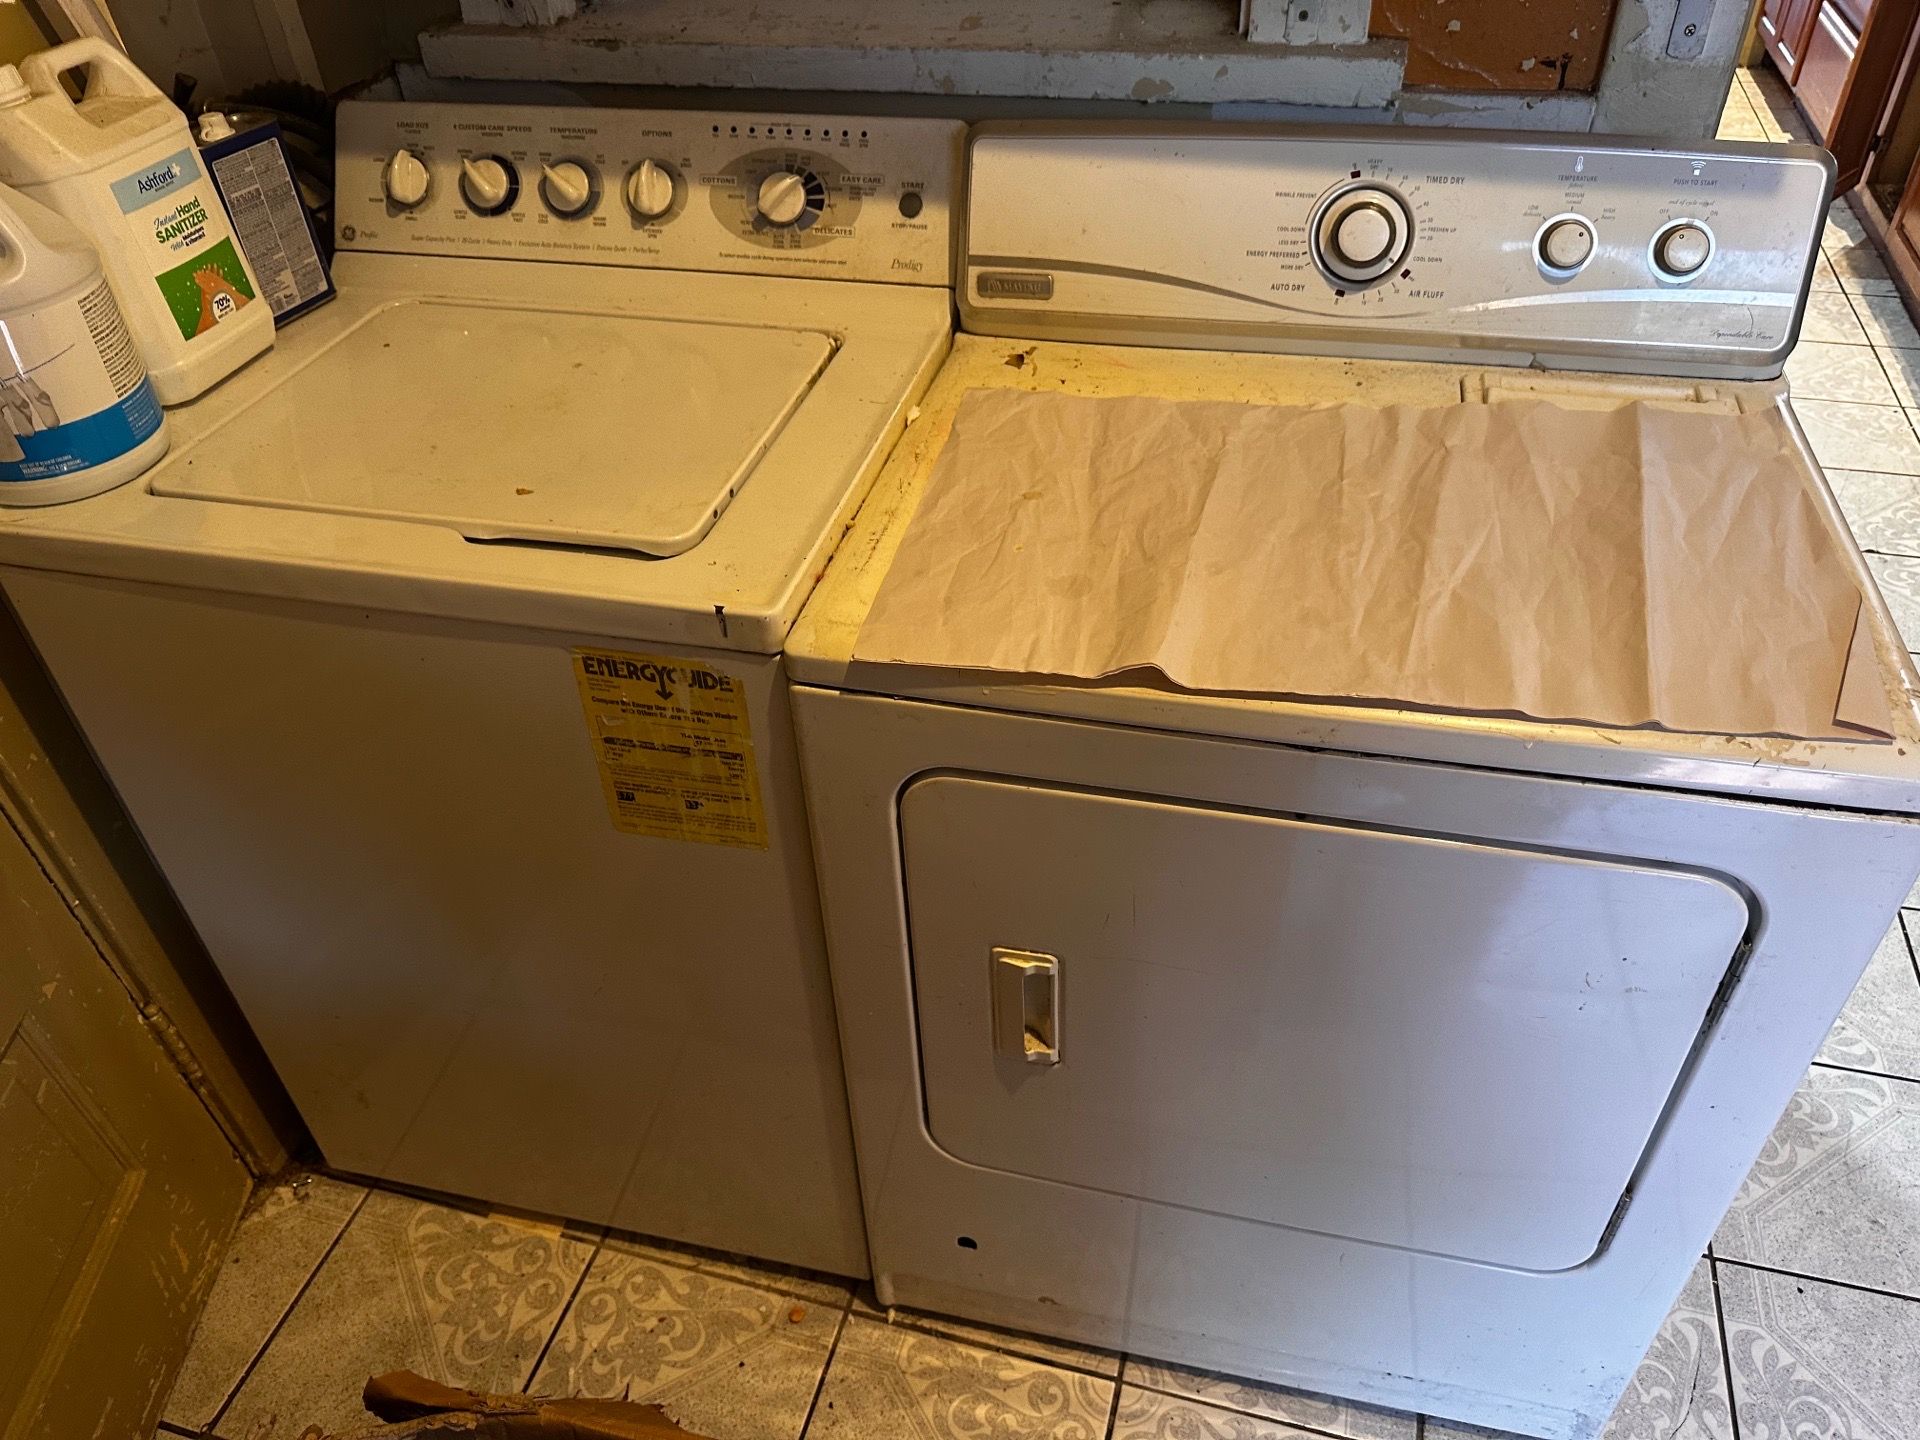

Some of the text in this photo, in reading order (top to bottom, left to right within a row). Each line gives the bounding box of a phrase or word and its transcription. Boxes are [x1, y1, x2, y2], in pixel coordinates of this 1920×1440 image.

[550, 127, 598, 135] TEMPERATURE
[642, 130, 672, 138] OPTIONS
[138, 166, 174, 194] Ashford
[702, 176, 736, 184] COTTONS
[863, 176, 881, 184] CARE
[1426, 176, 1465, 184] TIMED DRY
[176, 196, 200, 217] Hand
[156, 208, 208, 243] SANITIZER
[892, 222, 927, 230] STOP/PAUSE
[814, 227, 852, 236] DELICATES
[891, 258, 923, 272] Prodigy
[1271, 283, 1289, 291] AUTO
[1423, 291, 1444, 299] FLUFF
[214, 295, 231, 310] 70%
